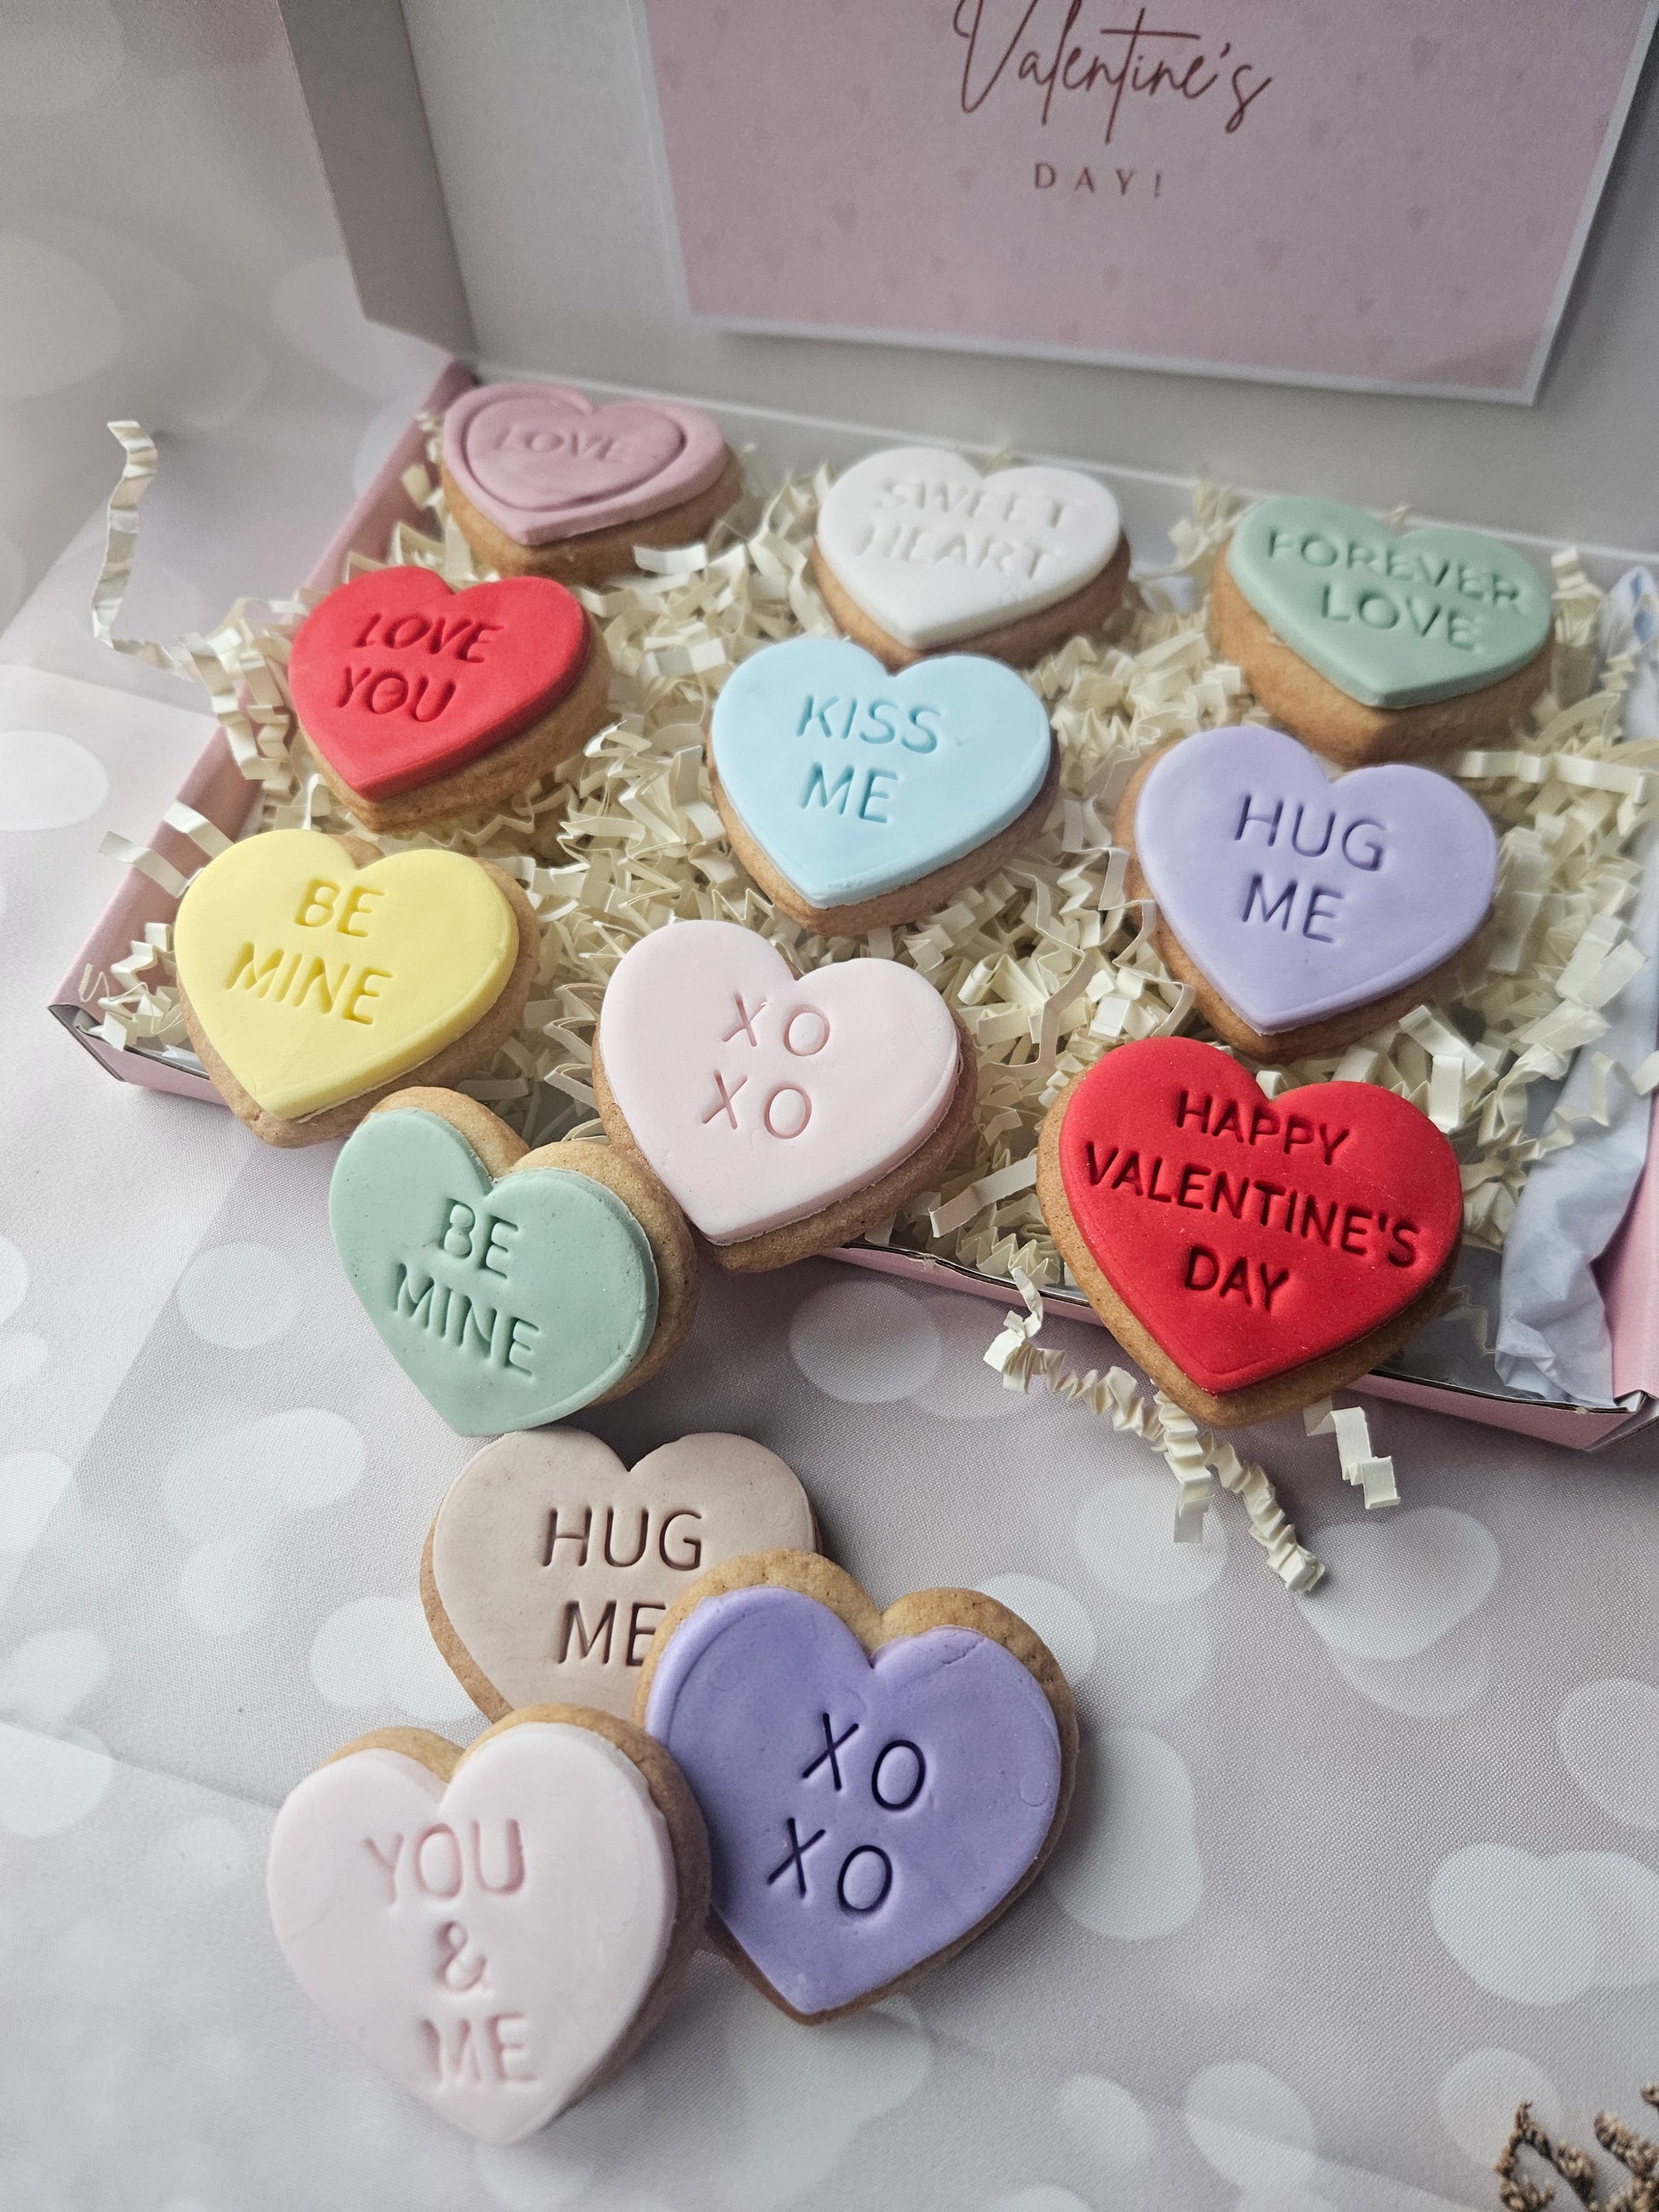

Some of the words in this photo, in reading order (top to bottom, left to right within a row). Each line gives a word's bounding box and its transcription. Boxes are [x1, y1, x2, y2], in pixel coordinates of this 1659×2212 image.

[953, 0, 1272, 144] Valentine's
[1033, 161, 1162, 199] DAY!
[494, 428, 627, 463] LOVE
[876, 478, 1081, 528] SWEET
[856, 525, 1059, 580] HEART
[1268, 528, 1523, 610] FOREVER
[355, 613, 503, 663] LOVE
[1321, 583, 1485, 652] LOVE
[338, 666, 456, 723] YOU
[796, 694, 943, 754] KISS
[800, 761, 899, 824] ME
[1234, 794, 1386, 872] HUG
[295, 878, 385, 938] BE
[1240, 873, 1346, 944] ME
[224, 940, 393, 1026] MINE
[1176, 1089, 1349, 1166] HAPPY
[441, 1198, 520, 1279] BE
[1084, 1141, 1421, 1268] VALENTINE'S
[1184, 1244, 1289, 1311] DAY
[394, 1262, 540, 1378] MINE
[541, 1505, 702, 1572] HUG
[558, 1599, 668, 1667] ME
[364, 1817, 527, 1905] YOU
[436, 1920, 490, 1993] &
[421, 2013, 538, 2088] ME
